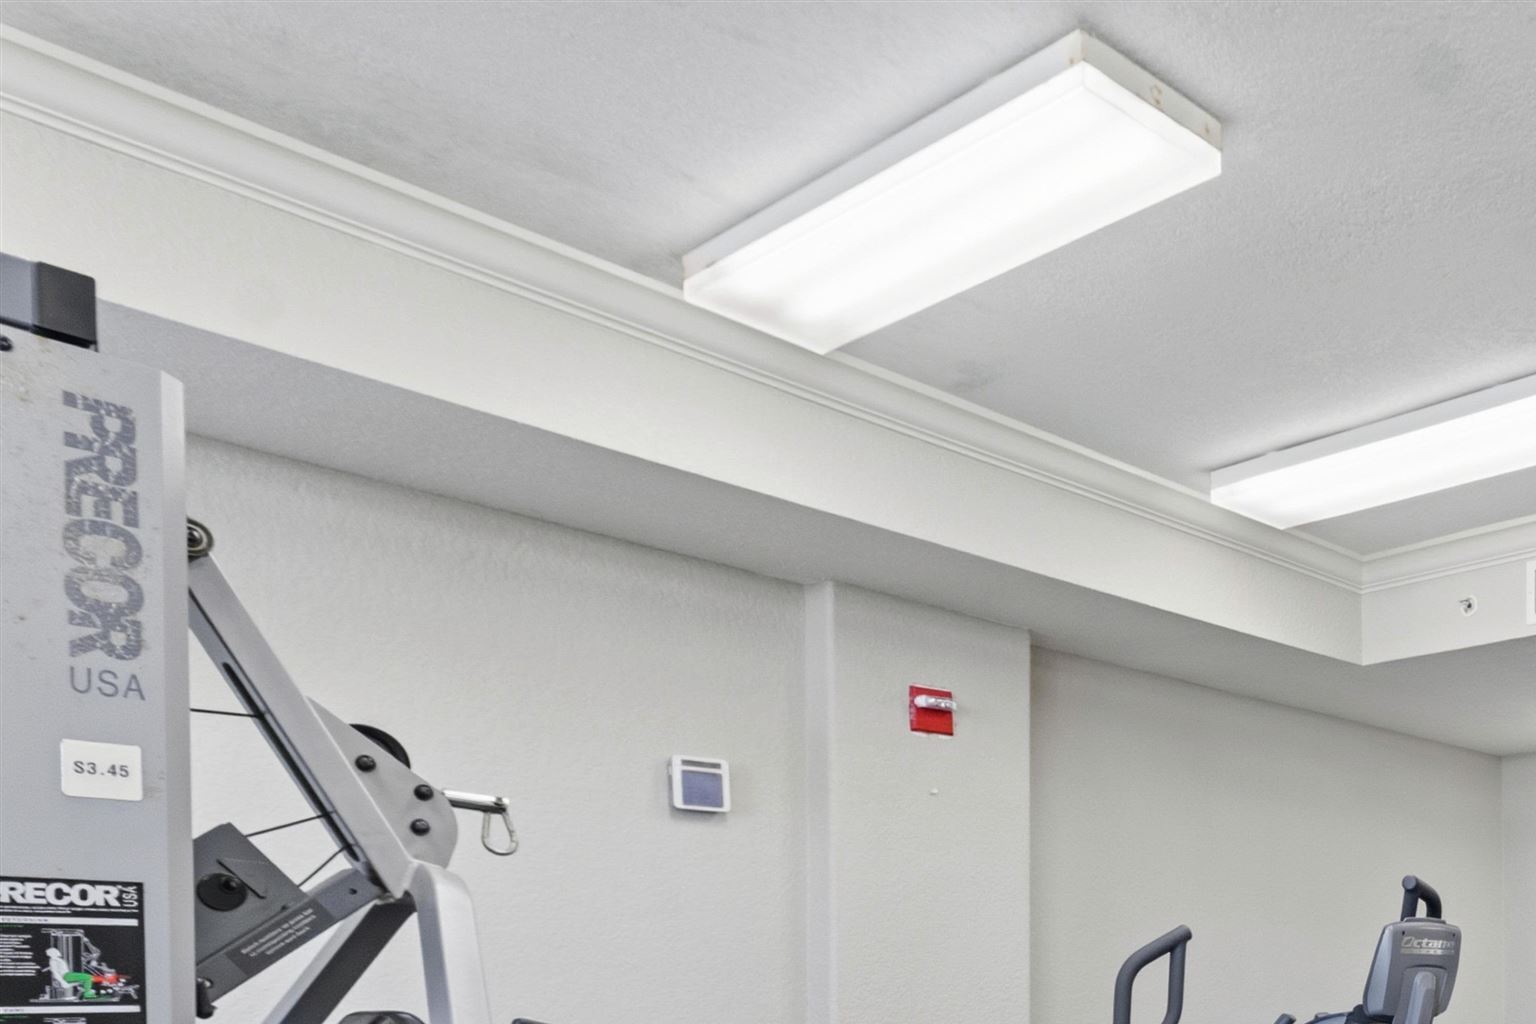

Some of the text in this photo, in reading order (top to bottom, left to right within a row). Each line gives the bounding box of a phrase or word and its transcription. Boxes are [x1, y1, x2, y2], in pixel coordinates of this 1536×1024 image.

[62, 389, 145, 662] PRECOR
[69, 667, 146, 701] USA
[73, 760, 129, 777] S3.45
[0, 881, 138, 907] RECOR USA
